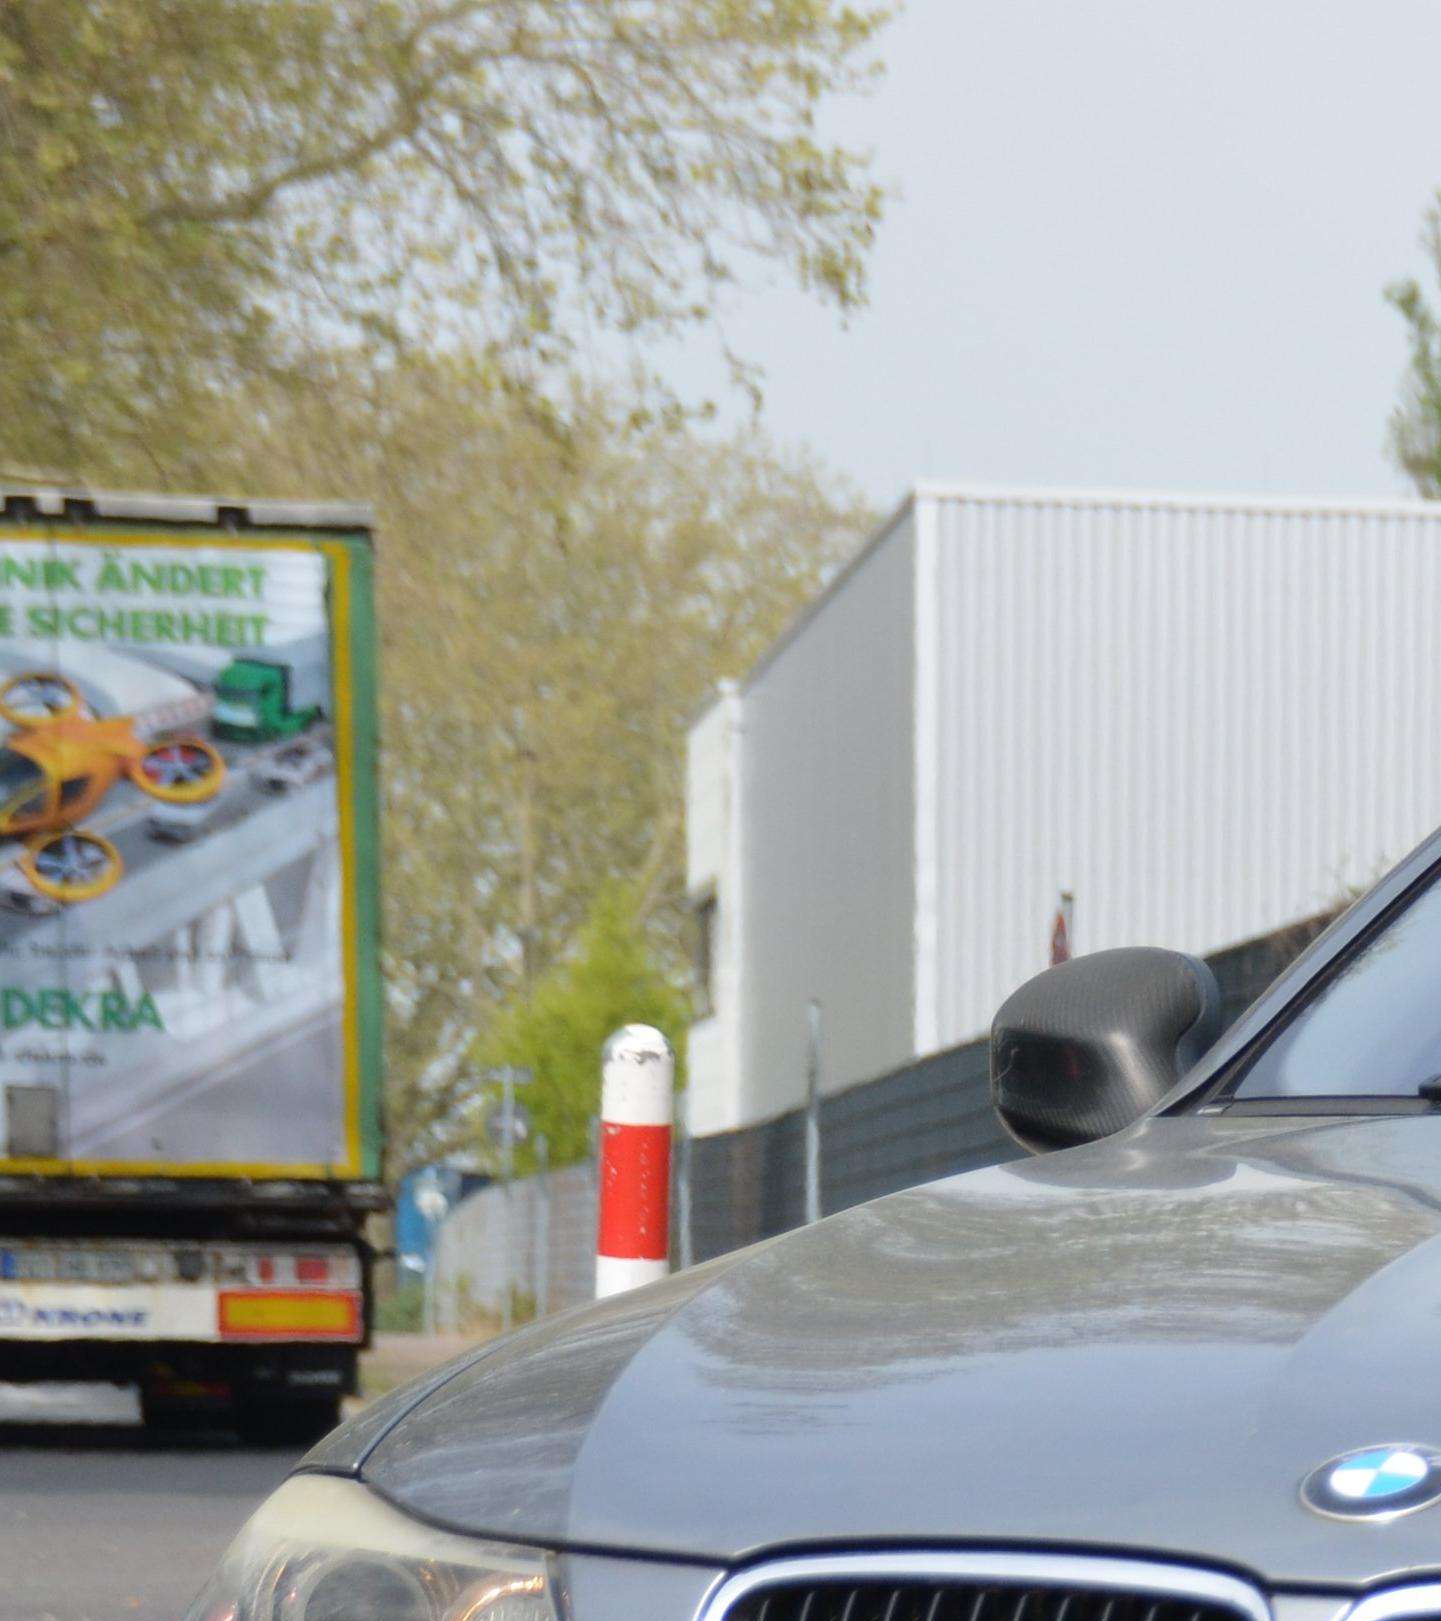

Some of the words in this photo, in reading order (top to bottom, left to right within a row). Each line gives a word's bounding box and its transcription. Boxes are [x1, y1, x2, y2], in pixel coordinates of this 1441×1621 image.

[96, 550, 267, 599] ÄNDERT
[27, 606, 269, 647] SICHERHEIT
[2, 986, 165, 1033] DEKRA
